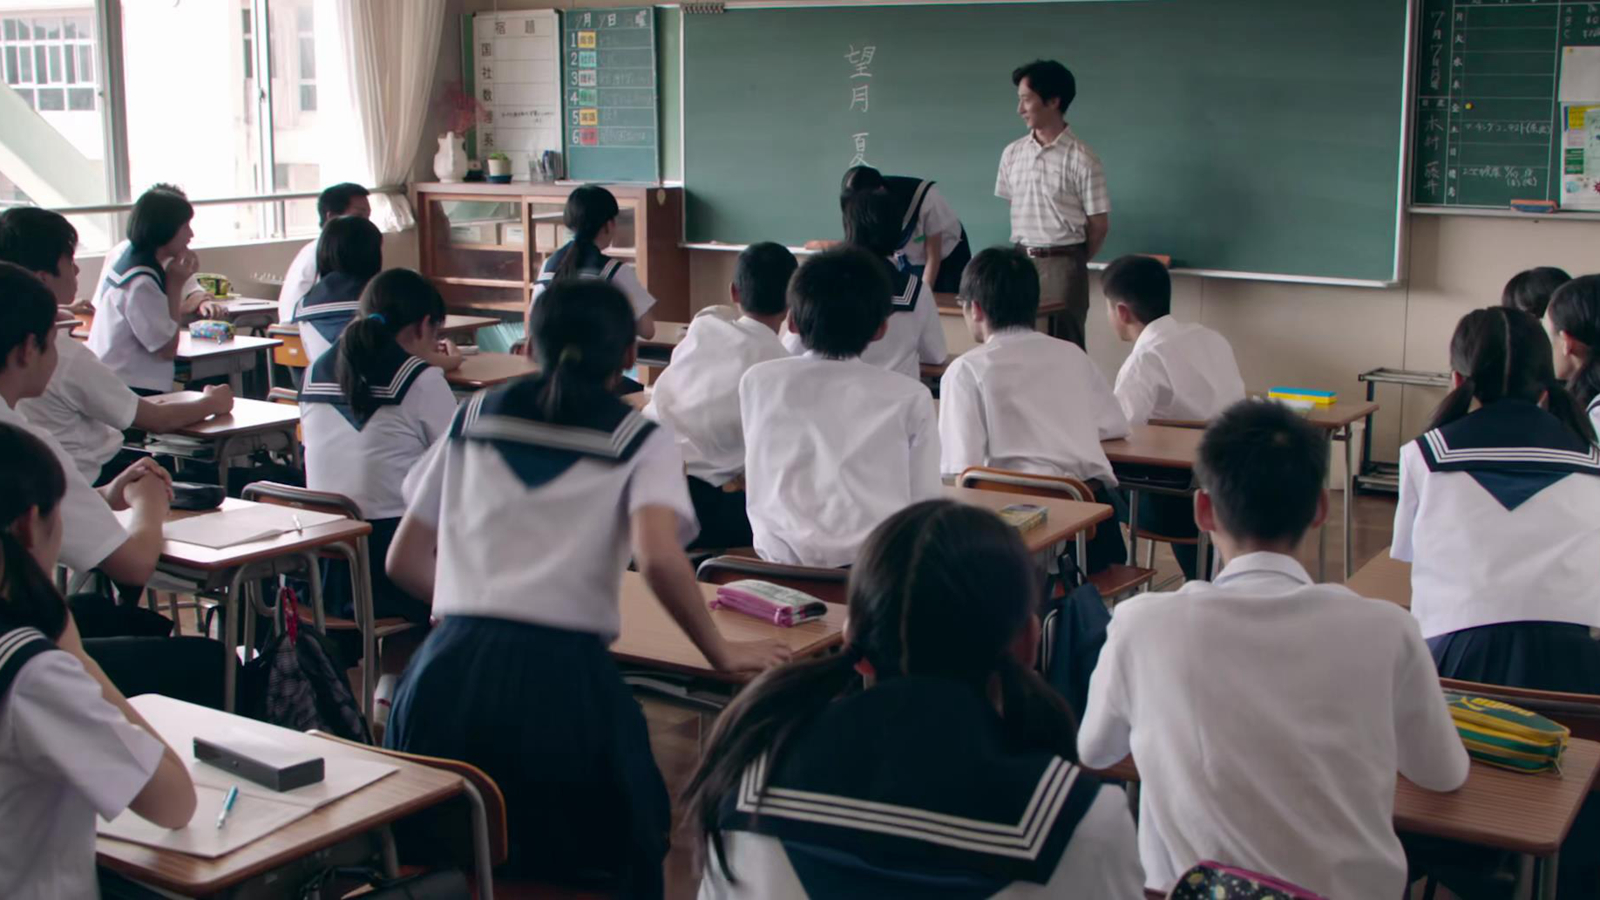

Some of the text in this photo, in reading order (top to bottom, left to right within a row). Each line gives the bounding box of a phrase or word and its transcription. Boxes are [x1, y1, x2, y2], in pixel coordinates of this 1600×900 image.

[570, 33, 576, 48] 1
[481, 43, 491, 57] 国
[570, 52, 577, 66] 2
[482, 66, 493, 79] 社
[571, 71, 578, 85] 3
[483, 88, 492, 102] 数
[570, 91, 578, 105] 4
[572, 110, 578, 125] 5
[484, 132, 494, 147] 英
[572, 128, 579, 144] 6
